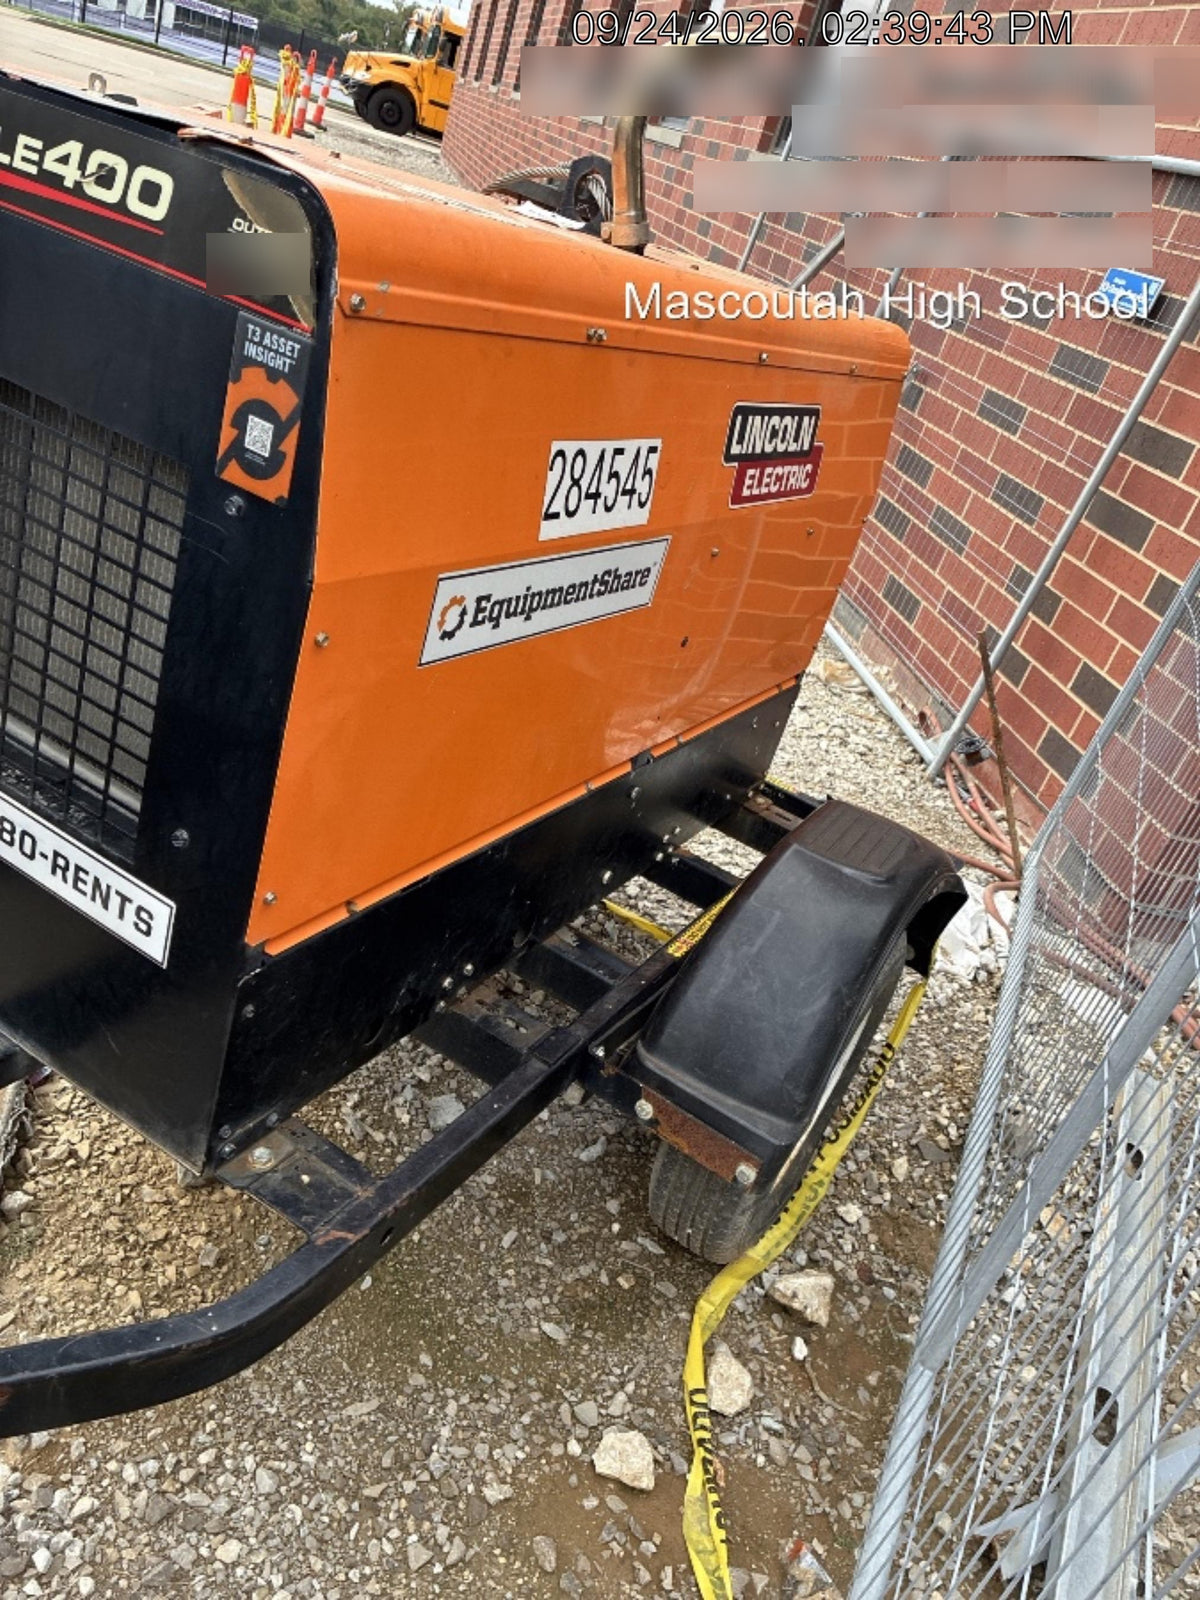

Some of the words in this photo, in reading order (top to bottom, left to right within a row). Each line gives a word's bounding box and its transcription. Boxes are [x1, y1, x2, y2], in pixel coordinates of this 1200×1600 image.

[244, 342, 292, 374] INSIGHT
[247, 323, 260, 342] T3
[262, 331, 301, 358] ASSET
[730, 415, 816, 454] LINCOLN
[542, 446, 658, 521] 284545
[741, 463, 813, 497] ELECTRIC
[469, 566, 651, 630] EquipmentShare
